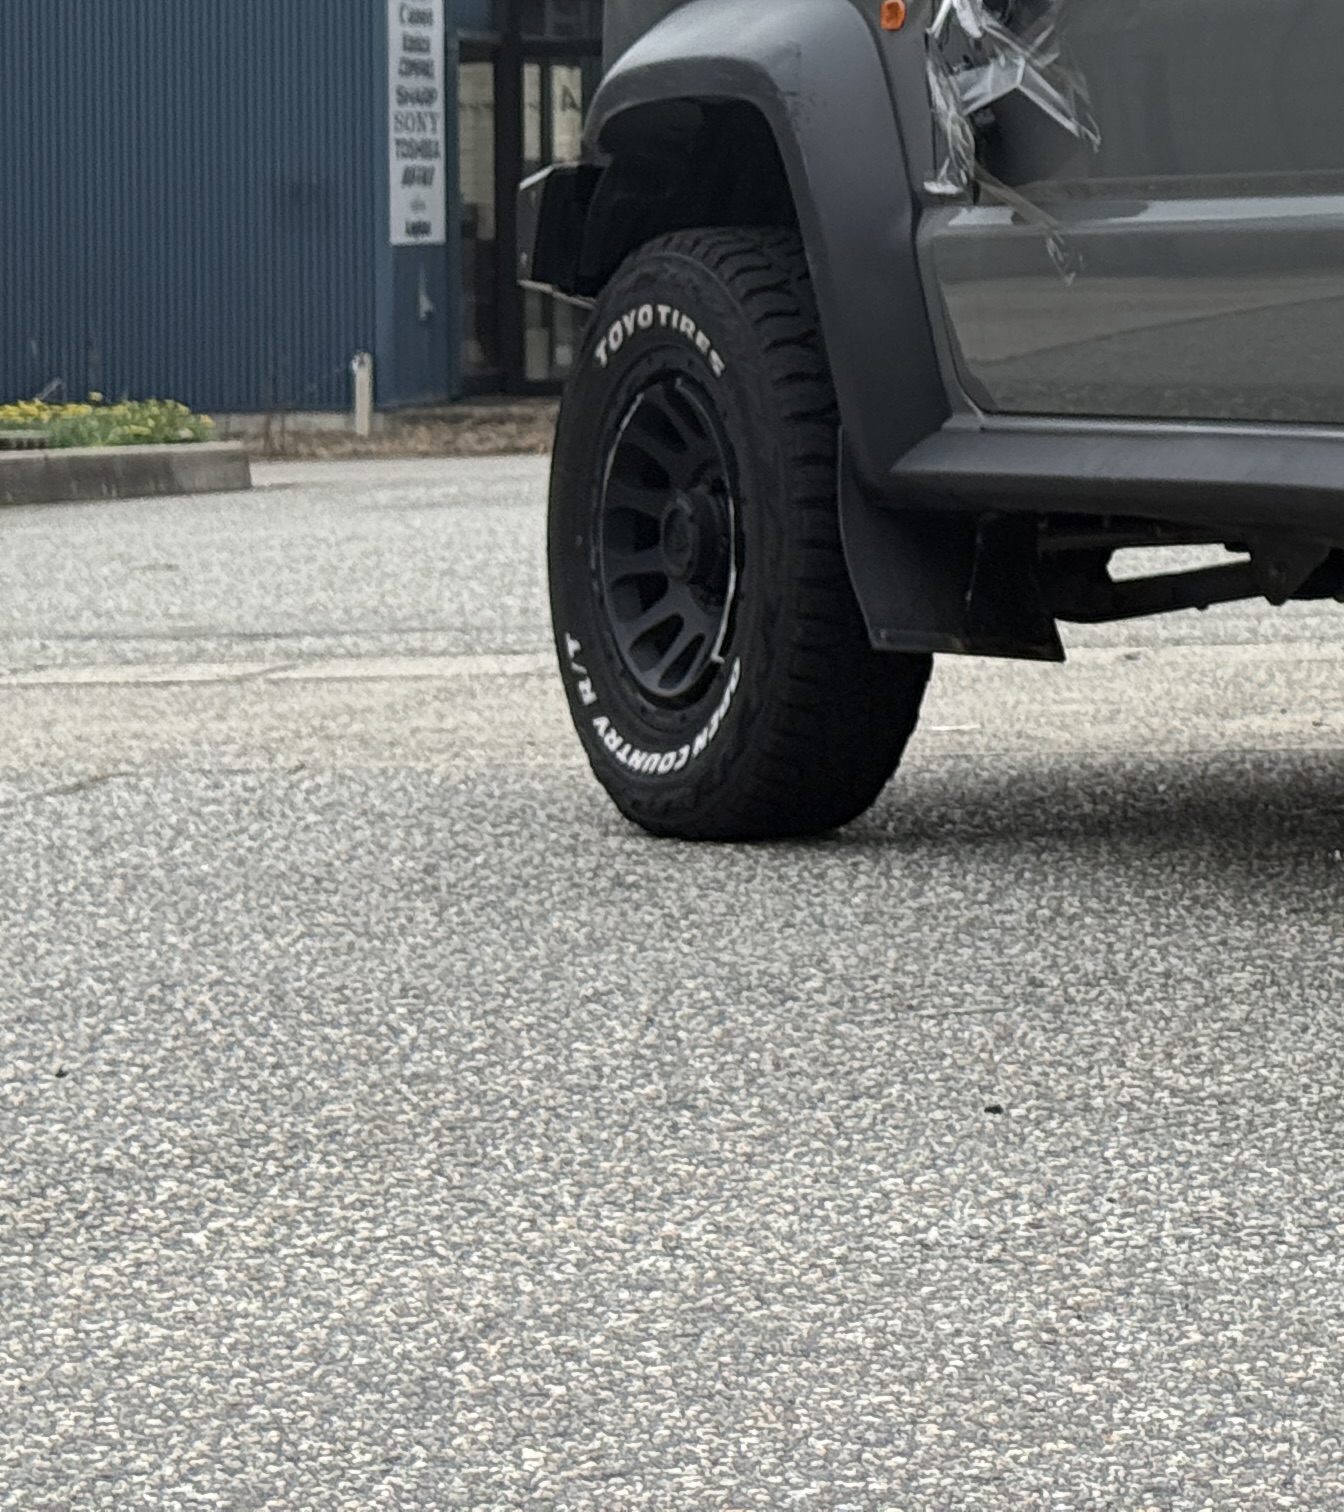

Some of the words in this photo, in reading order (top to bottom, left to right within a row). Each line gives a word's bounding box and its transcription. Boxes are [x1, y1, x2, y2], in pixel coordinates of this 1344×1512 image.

[394, 112, 440, 133] SONY
[594, 304, 655, 369] TOYO
[656, 304, 726, 378] TIRES
[592, 715, 690, 775] COUNTRY
